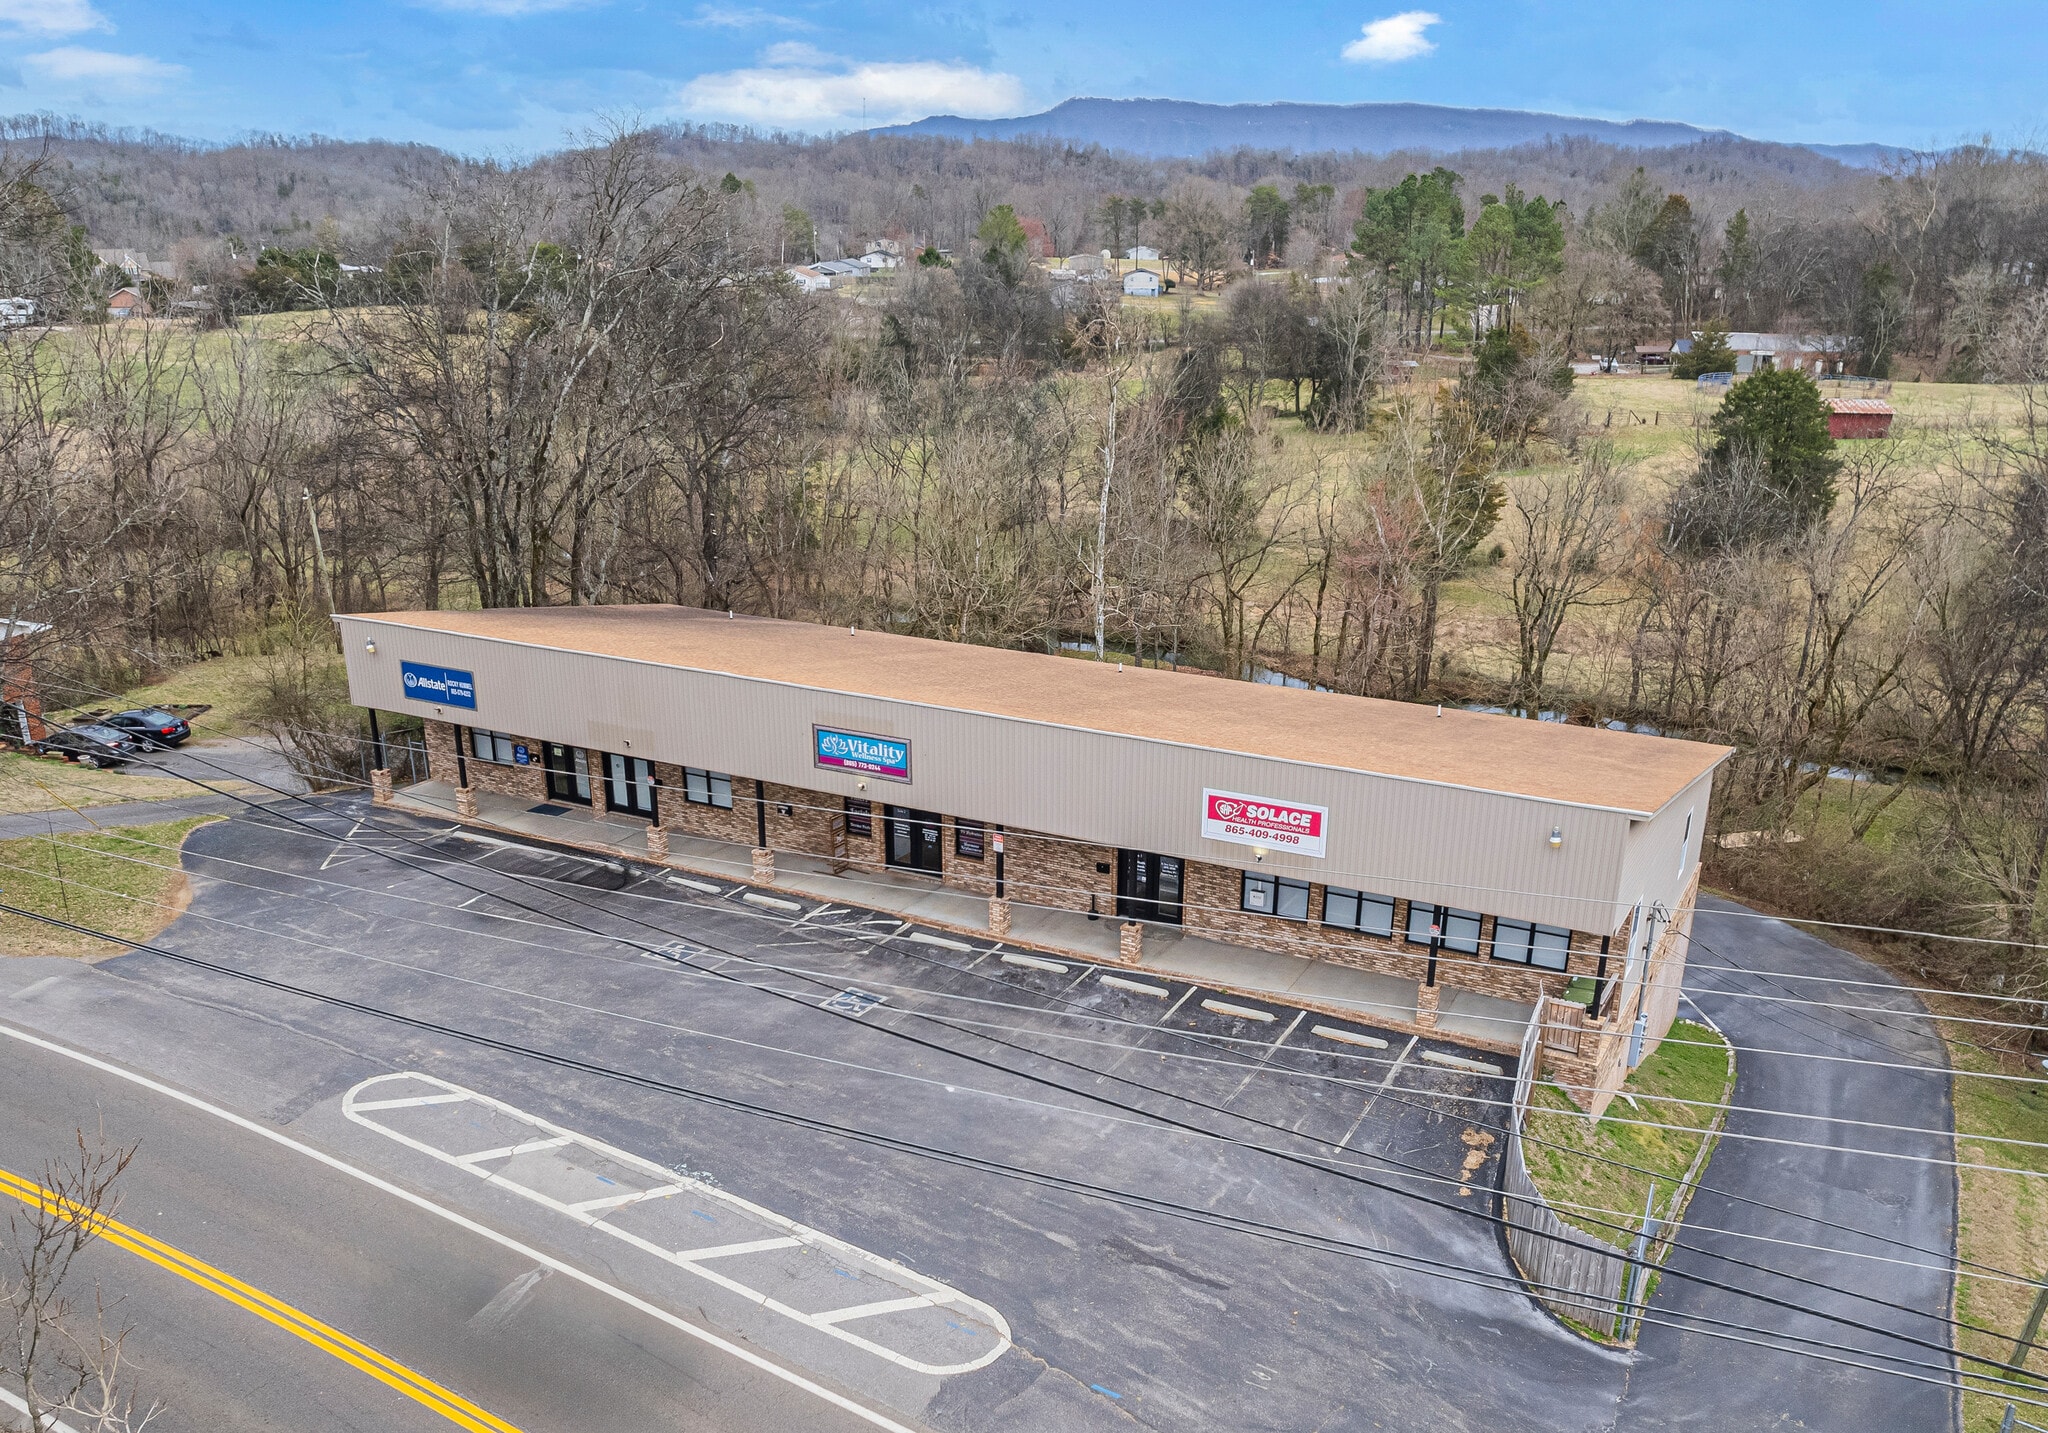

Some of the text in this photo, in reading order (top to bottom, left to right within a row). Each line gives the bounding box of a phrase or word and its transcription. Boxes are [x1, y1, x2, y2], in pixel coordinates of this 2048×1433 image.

[418, 677, 446, 691] Allstate
[847, 738, 905, 762] Vitality
[851, 751, 896, 765] Wellness Spa
[1231, 816, 1310, 834] HEALTH PROFESSIONALS
[1246, 804, 1312, 827] SOLACE
[1225, 824, 1300, 845] 865-409-4998
